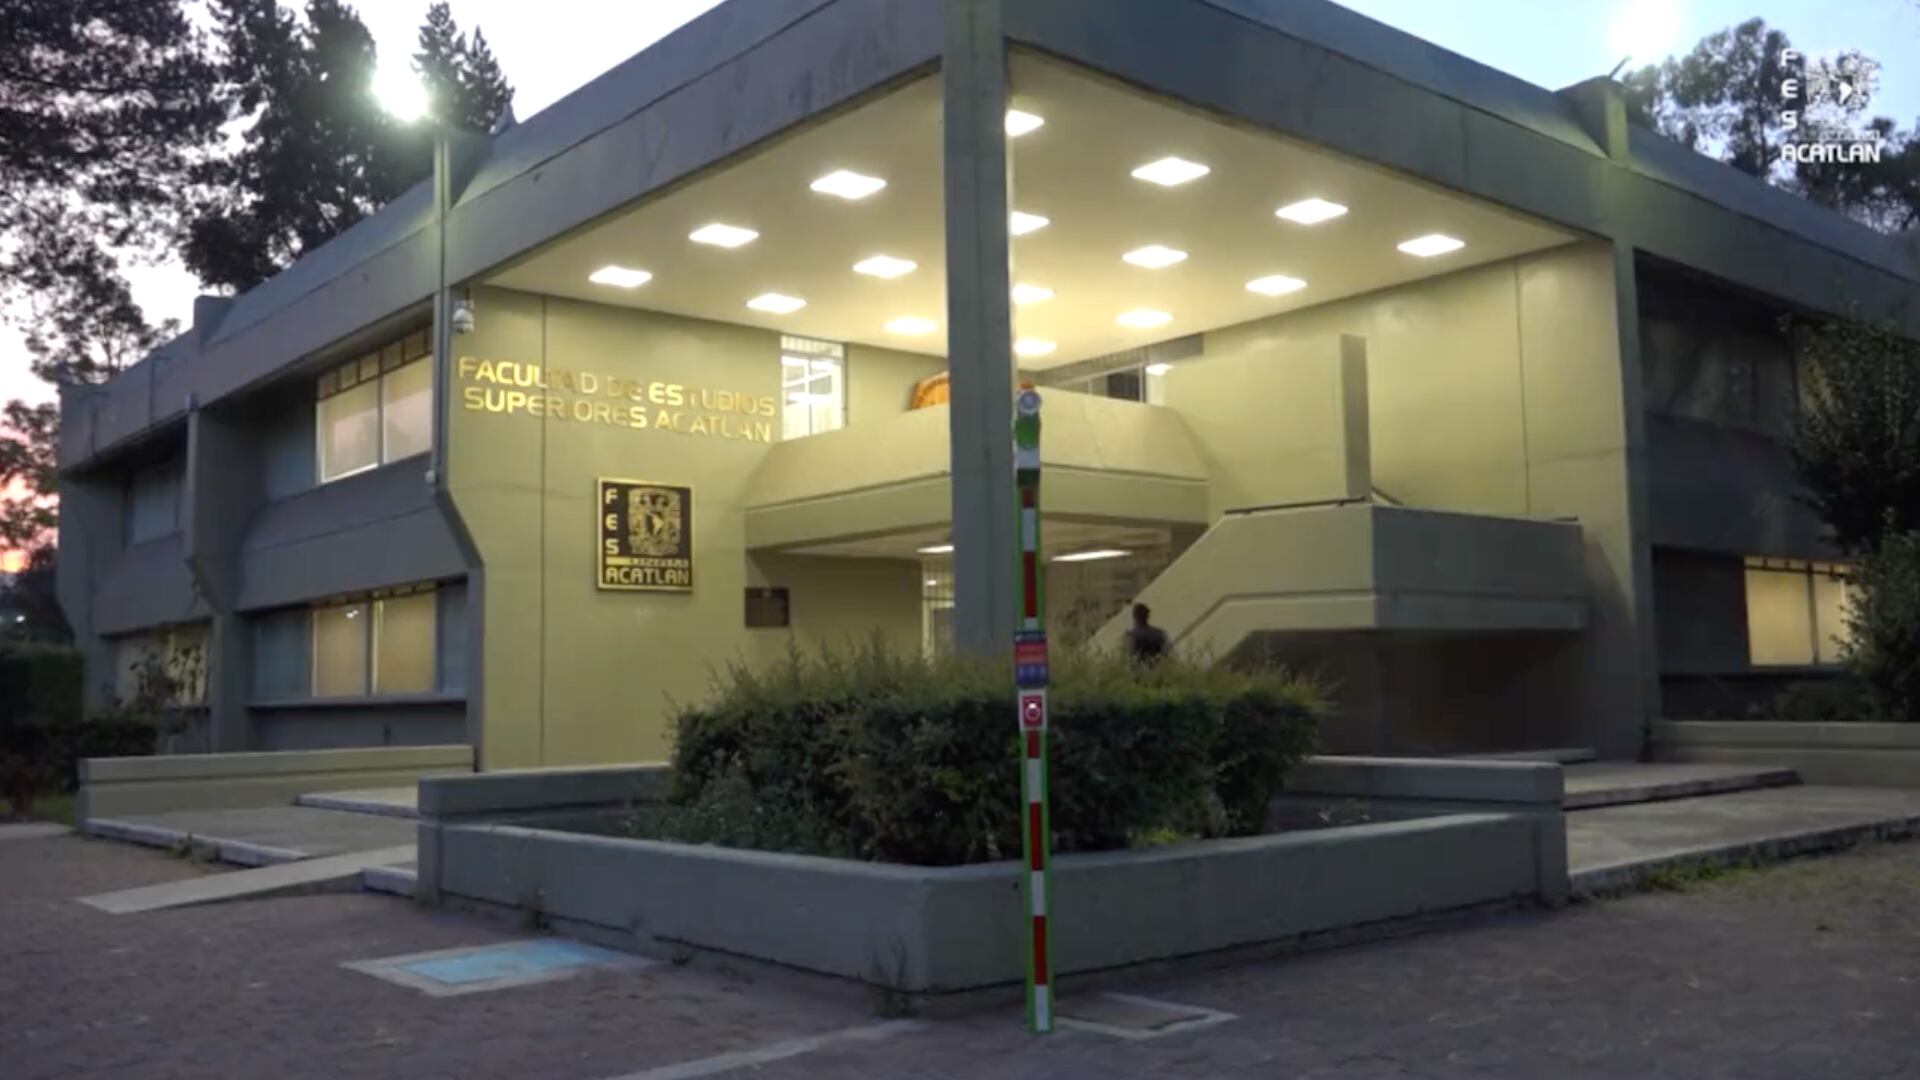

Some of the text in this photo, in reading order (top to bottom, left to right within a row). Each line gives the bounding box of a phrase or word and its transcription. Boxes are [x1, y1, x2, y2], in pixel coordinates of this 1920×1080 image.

[464, 386, 771, 442] SUPERIORES ACATLAN
[648, 382, 776, 417] ESTUDIOS
[606, 567, 689, 584] ACATLAN
